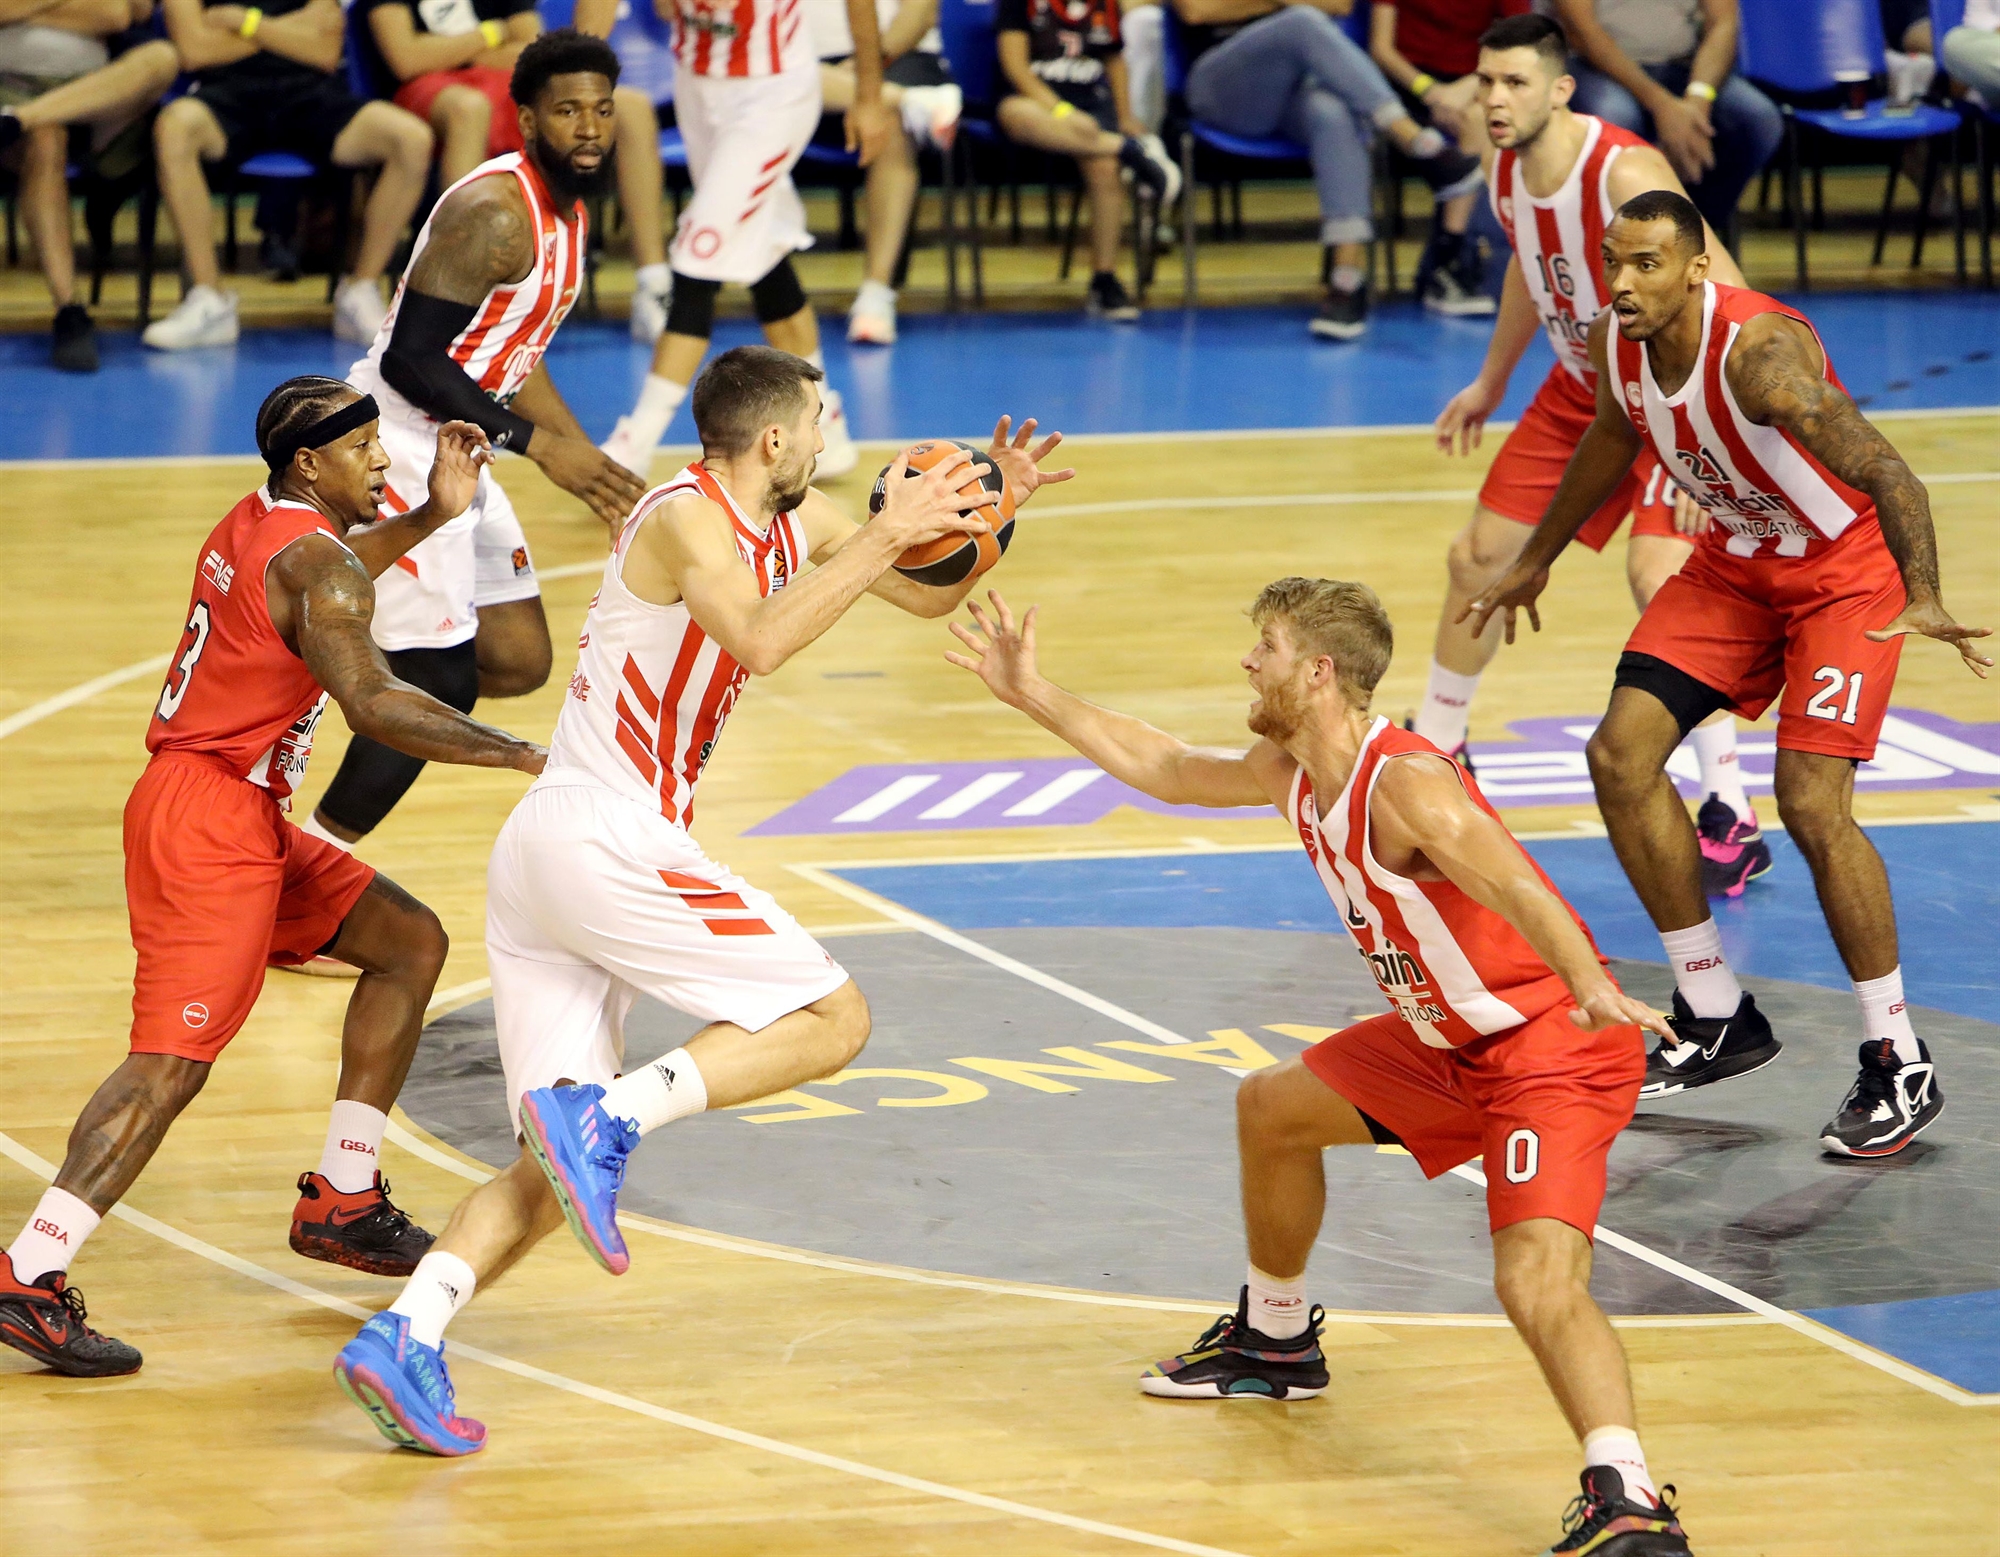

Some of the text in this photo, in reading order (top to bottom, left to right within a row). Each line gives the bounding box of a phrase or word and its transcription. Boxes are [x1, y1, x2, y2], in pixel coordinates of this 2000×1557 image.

[1536, 254, 1575, 297] 16
[1676, 446, 1733, 484] 21
[154, 597, 211, 725] 3
[1805, 664, 1864, 726] 21
[1685, 955, 1723, 972] GSA
[340, 1138, 376, 1157] GSA
[1505, 1127, 1540, 1185] 0
[33, 1217, 68, 1246] GSA
